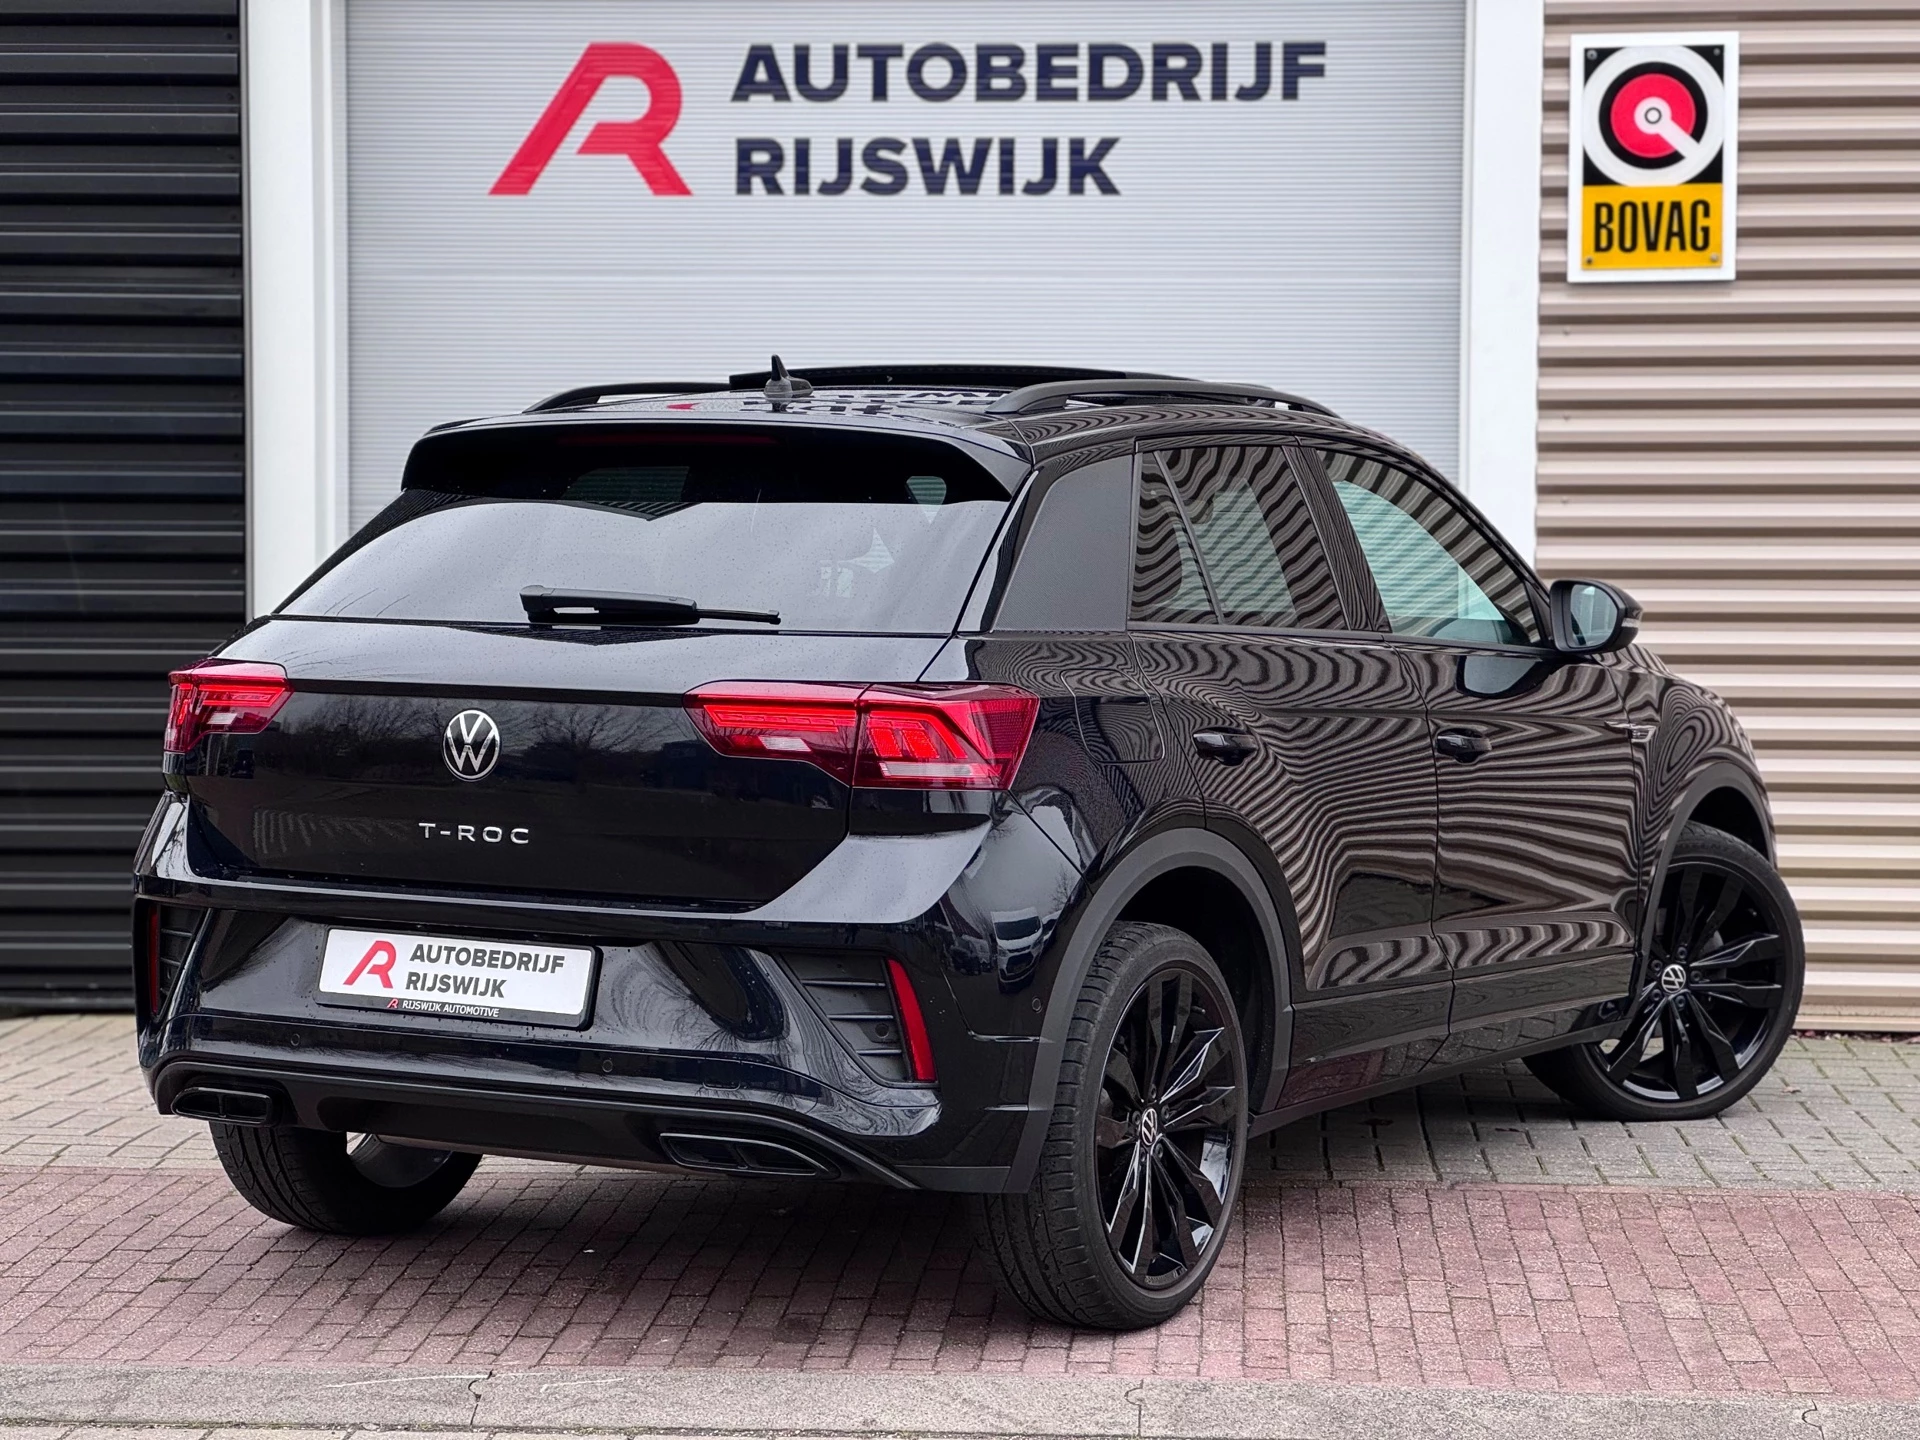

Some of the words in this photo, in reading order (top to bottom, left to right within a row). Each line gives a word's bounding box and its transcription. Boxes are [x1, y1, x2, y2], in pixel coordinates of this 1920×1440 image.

[732, 42, 1326, 102] AUTOBEDRIJF
[735, 137, 1121, 196] RIJSWIJK
[1594, 199, 1711, 253] BOVAG
[418, 822, 529, 845] T-ROC
[410, 944, 565, 973] AUTOBEDRIJF
[405, 971, 507, 998] RIJSWIJK
[402, 1000, 442, 1012] RIJSWIJK
[443, 1004, 500, 1018] AUTOMOTIVE
